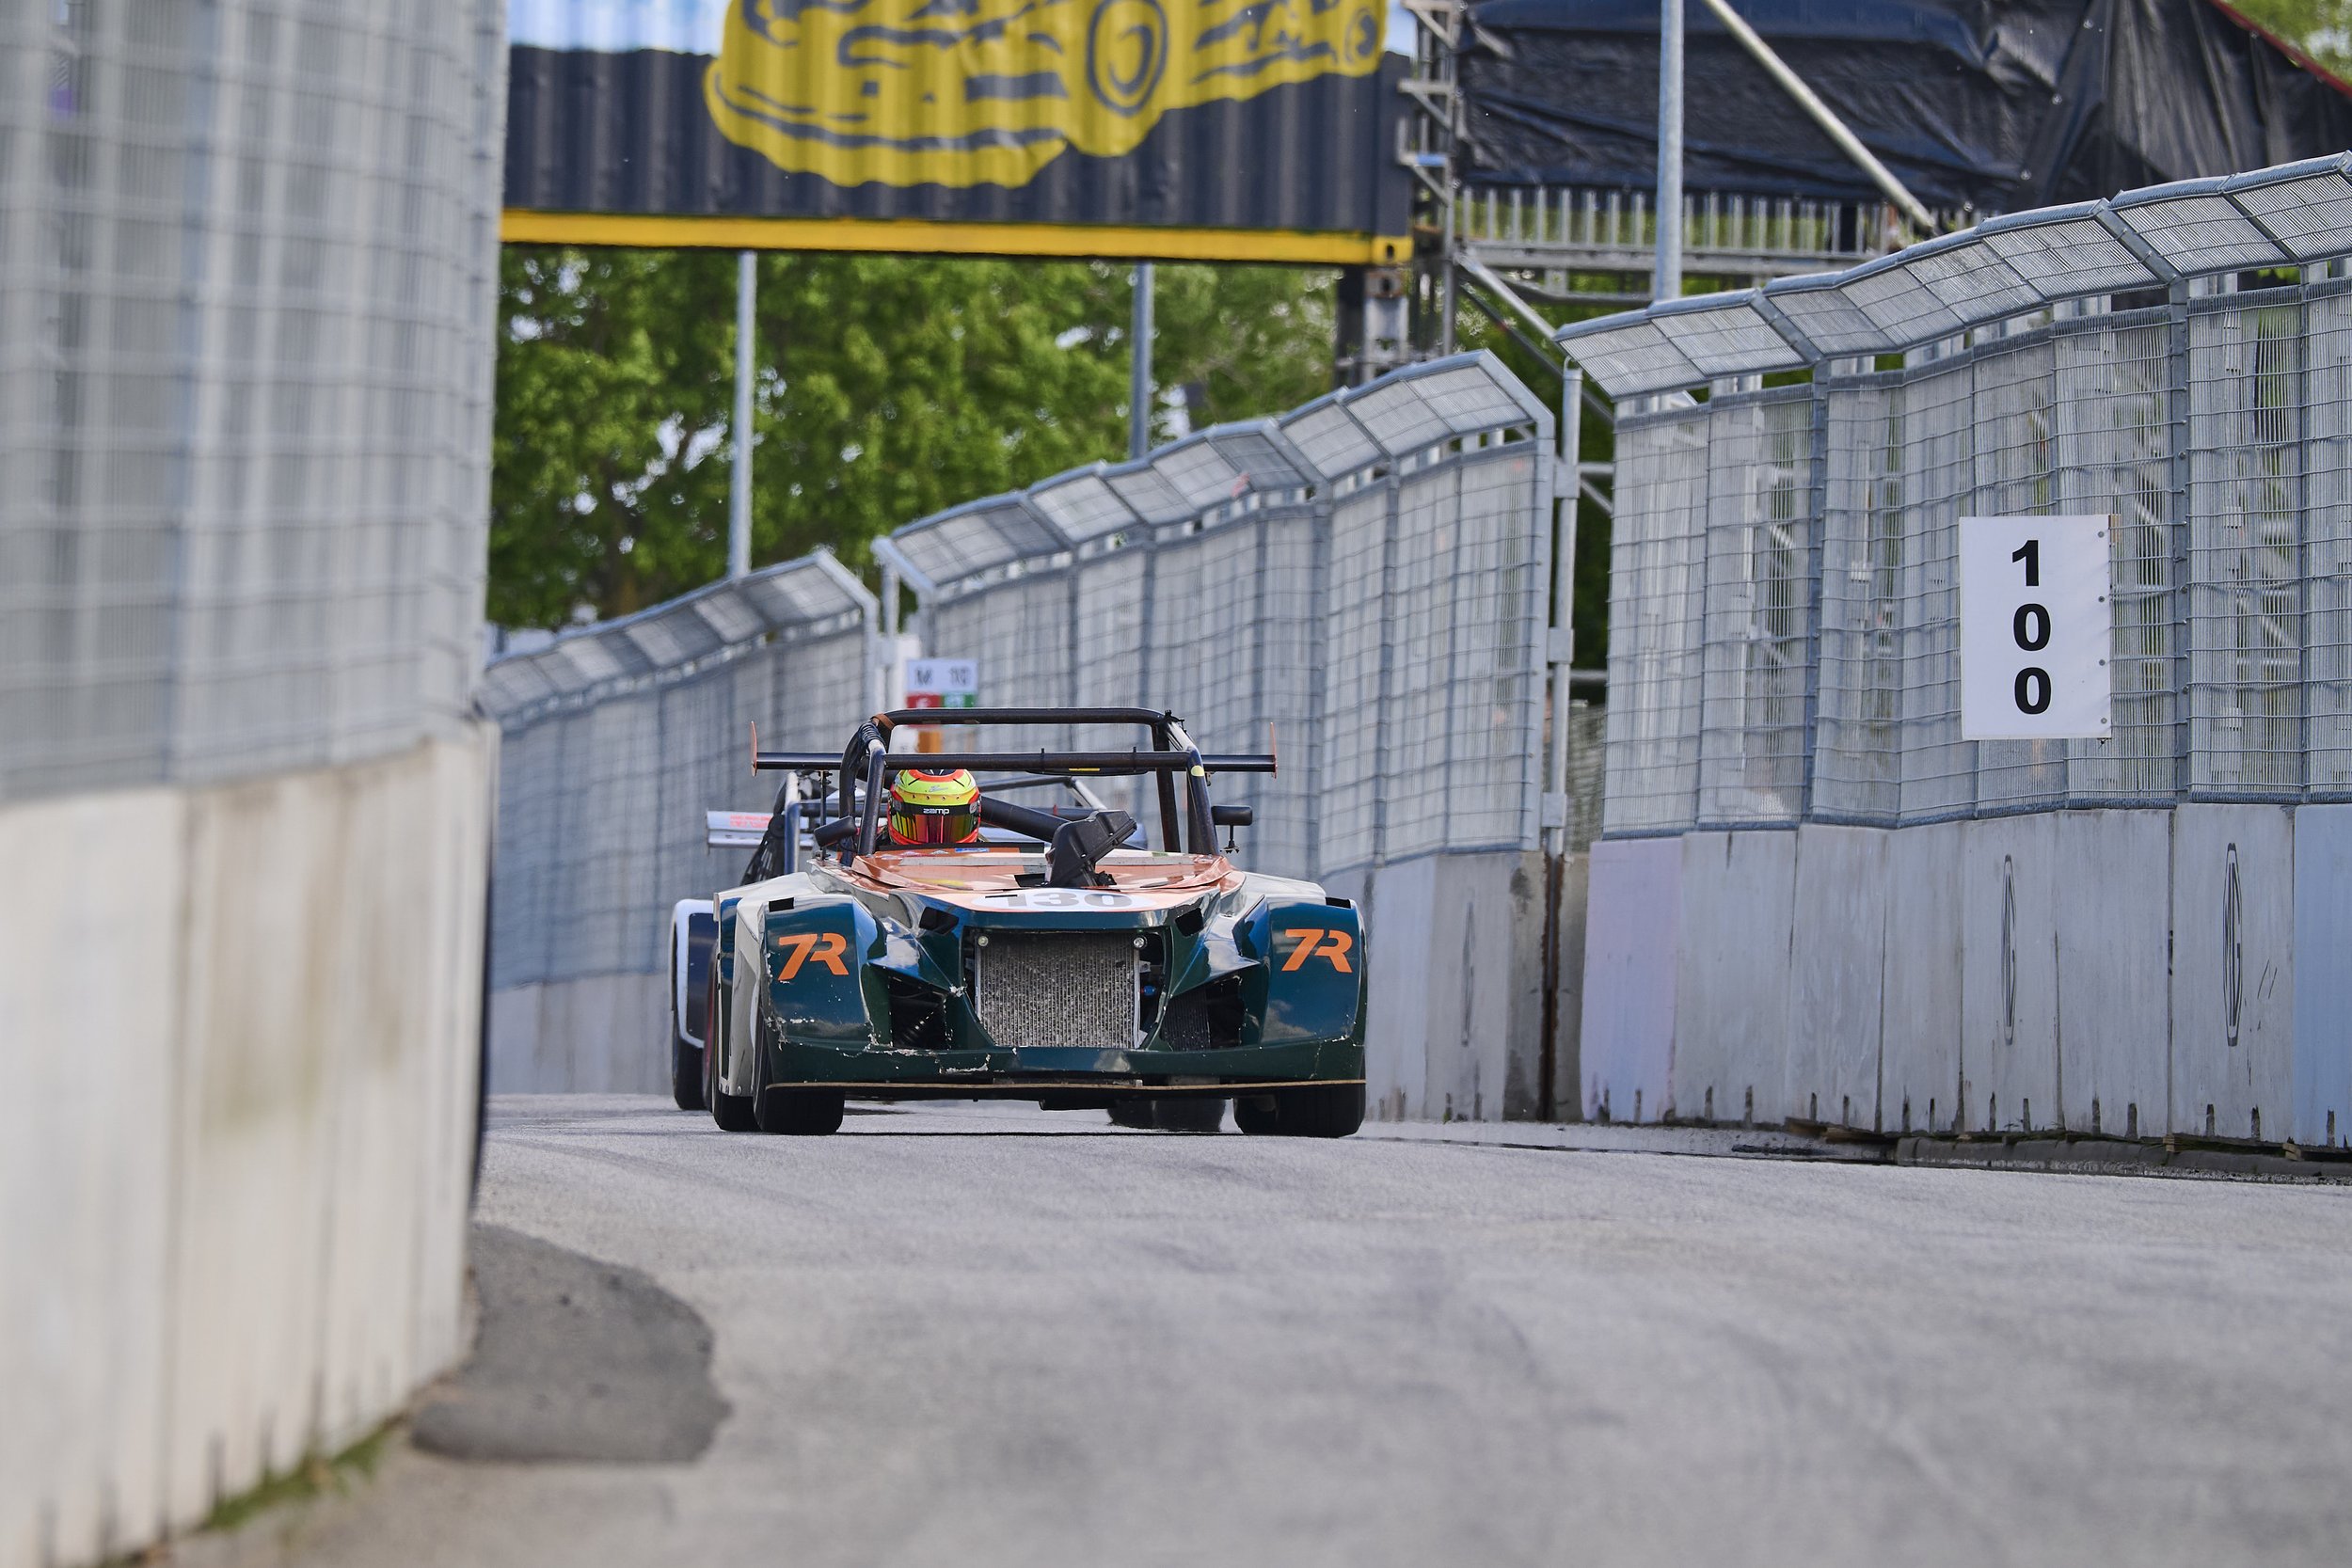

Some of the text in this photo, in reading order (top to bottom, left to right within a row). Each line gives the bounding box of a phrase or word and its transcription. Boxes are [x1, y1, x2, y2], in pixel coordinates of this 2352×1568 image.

[2011, 539, 2052, 715] 100
[1007, 893, 1133, 908] 130
[777, 932, 850, 981] 7R
[1280, 928, 1353, 974] 7R
